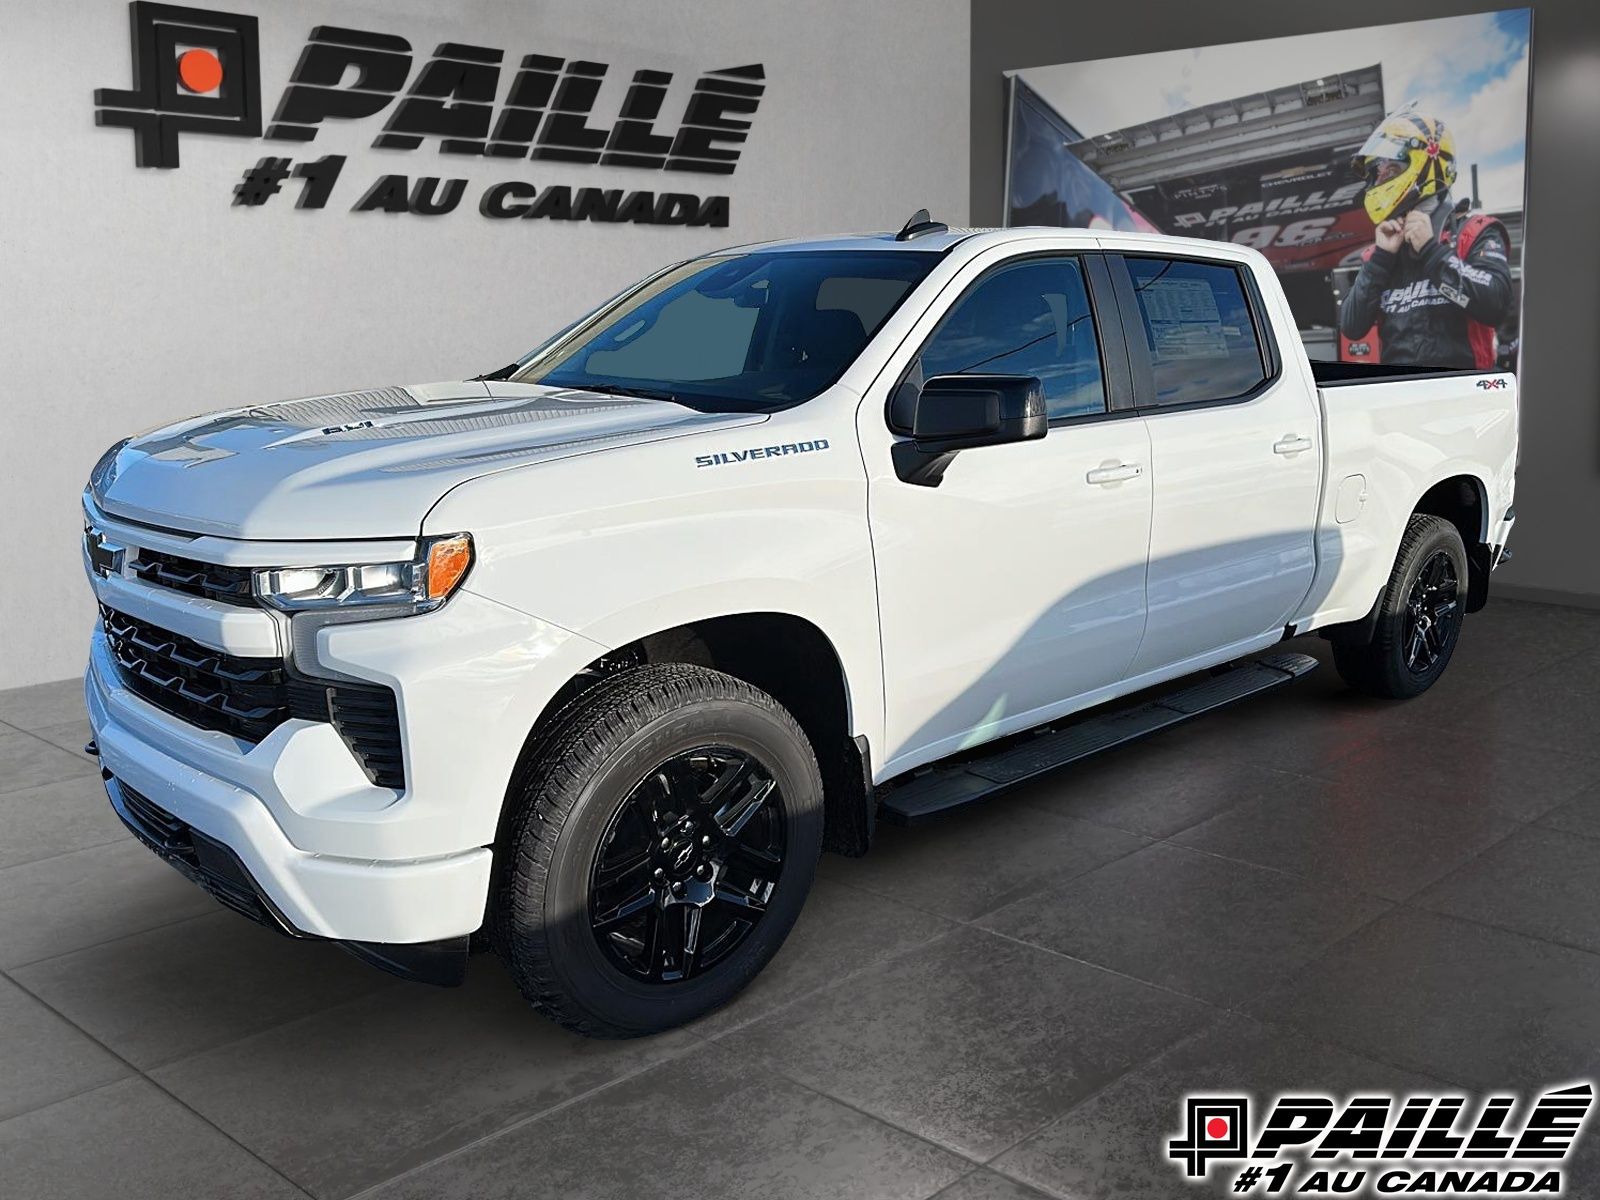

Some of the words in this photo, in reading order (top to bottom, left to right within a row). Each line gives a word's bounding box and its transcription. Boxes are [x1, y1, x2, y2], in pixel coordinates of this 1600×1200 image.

[263, 25, 765, 174] PAILLÉ
[231, 154, 347, 209] #1
[349, 174, 469, 215] AU
[478, 181, 730, 228] CANADA
[1261, 171, 1333, 188] CHEVROLET
[1265, 200, 1354, 218] CANADA
[1231, 217, 1336, 249] 96
[695, 439, 830, 468] SILVERADO
